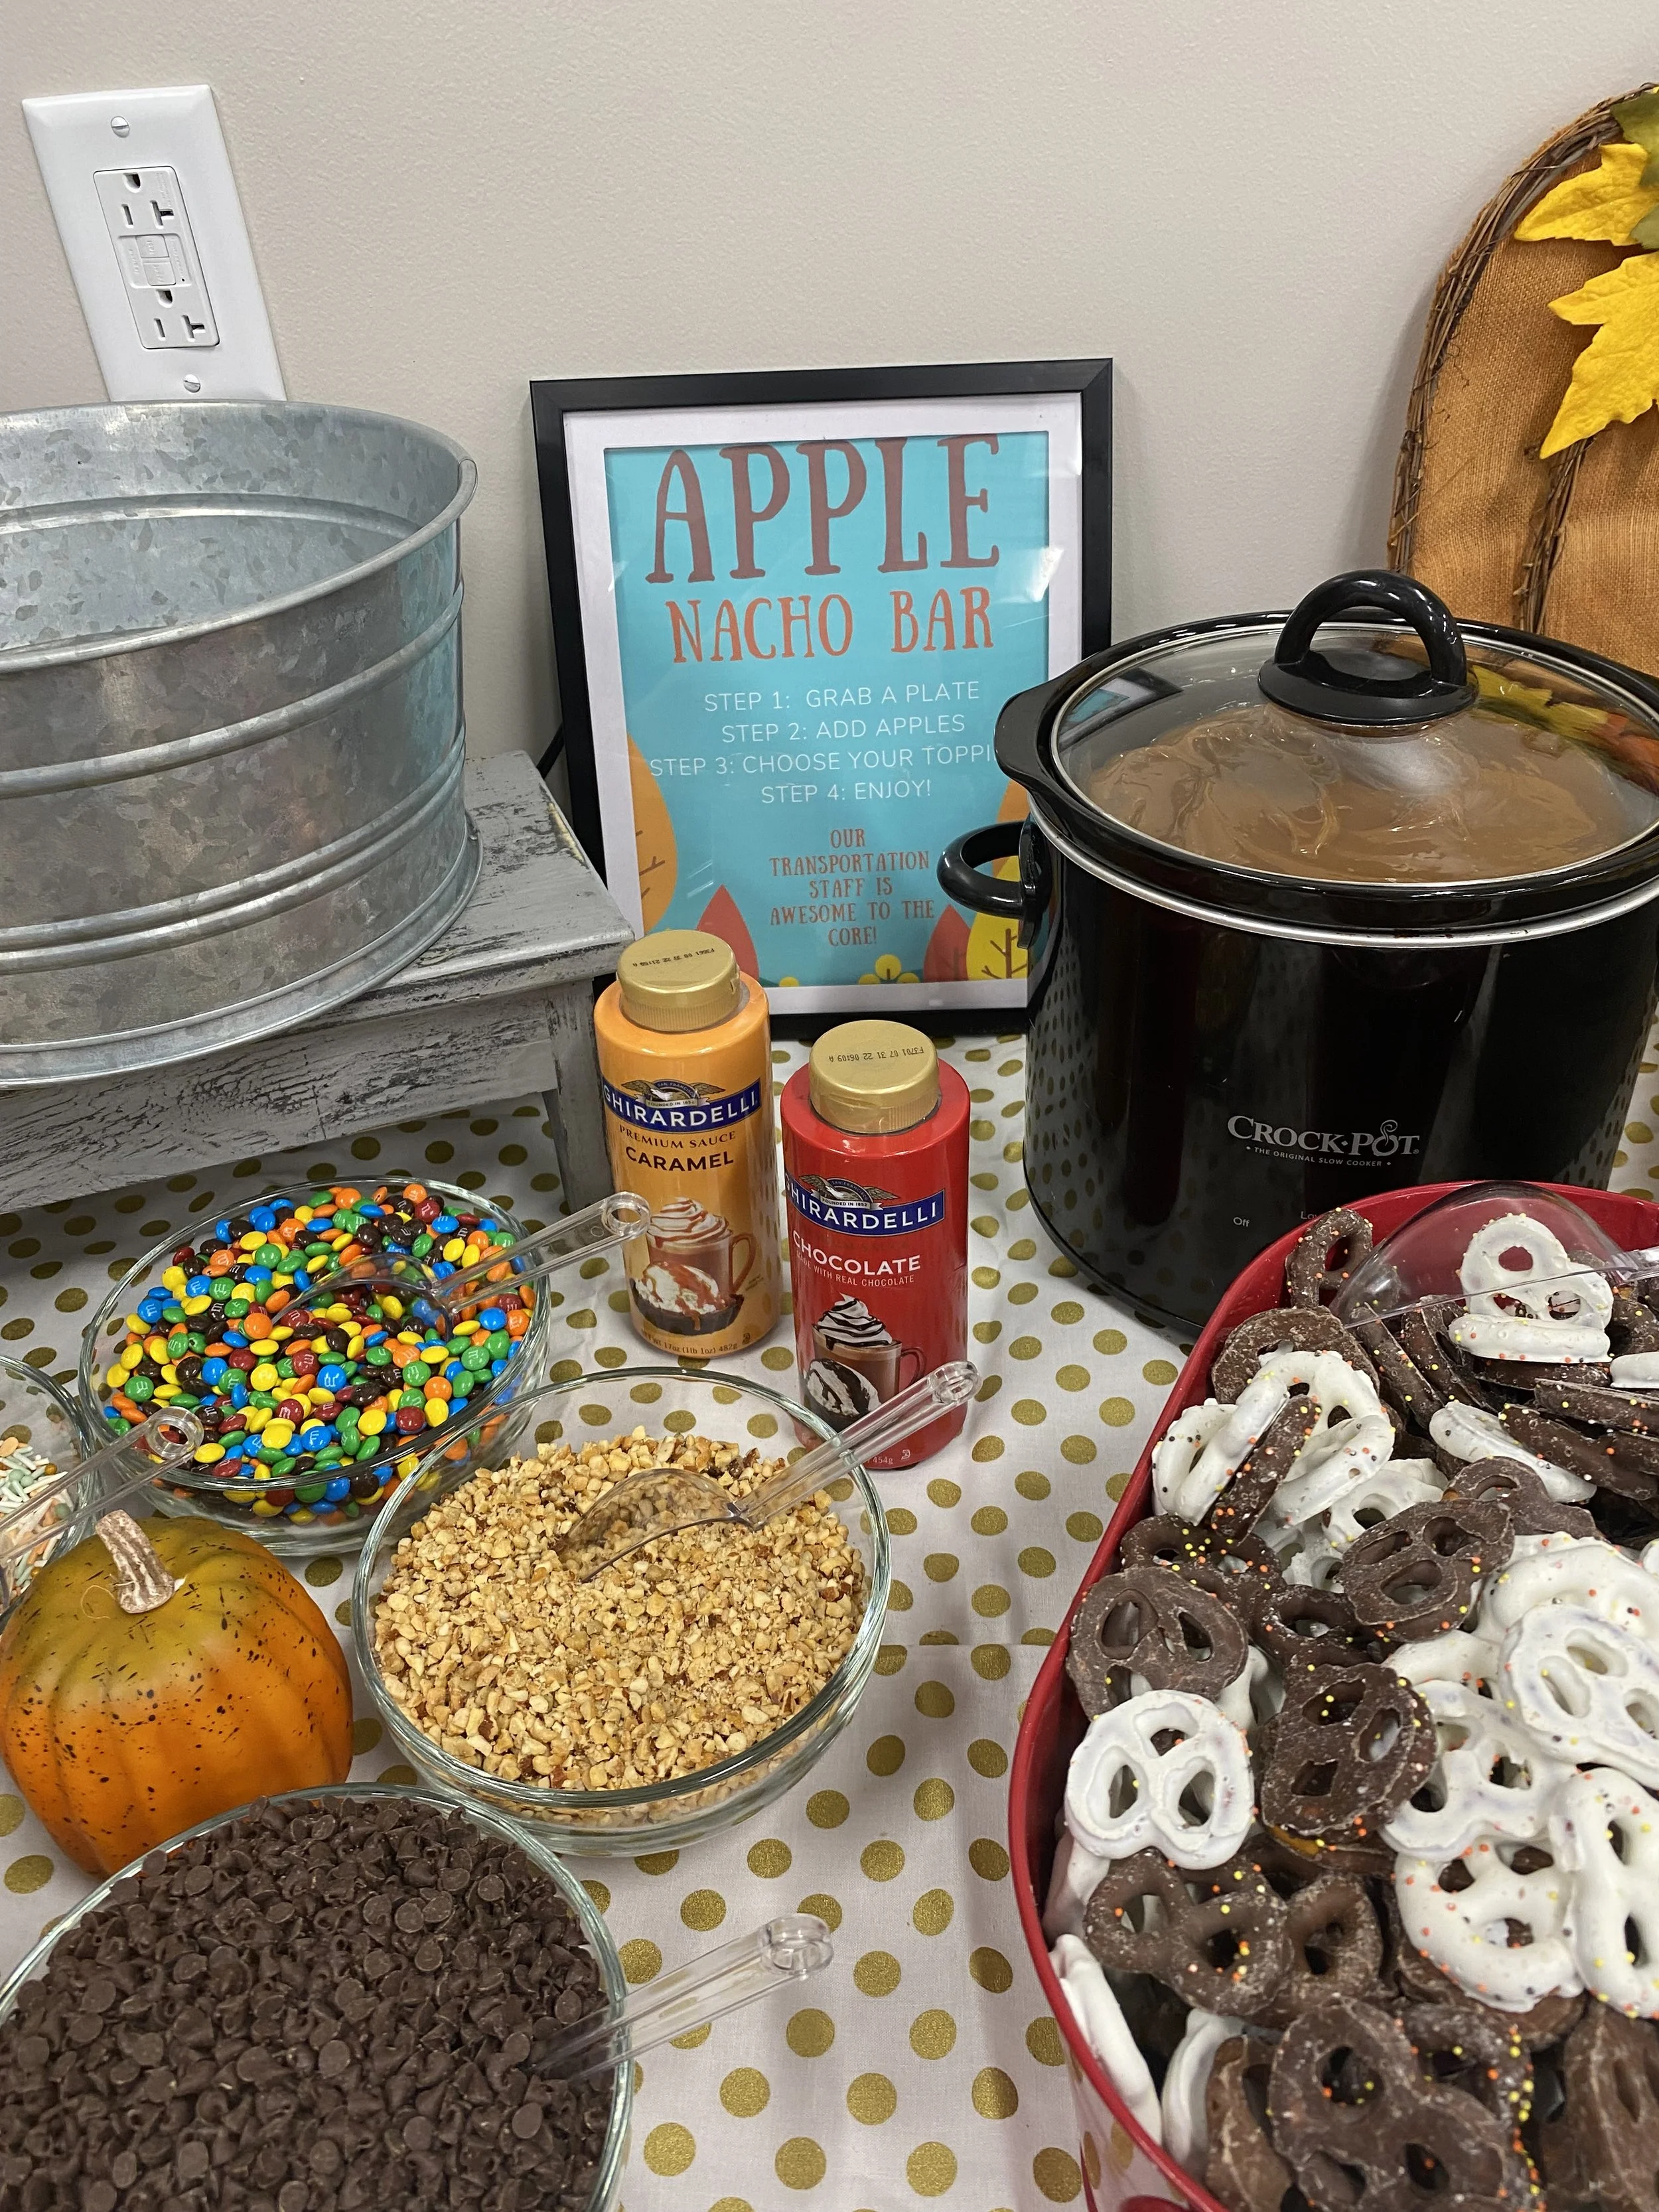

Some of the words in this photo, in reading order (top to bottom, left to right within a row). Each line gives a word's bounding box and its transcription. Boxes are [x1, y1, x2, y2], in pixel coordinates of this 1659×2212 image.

[645, 433, 1000, 584] APPLE
[666, 593, 853, 663] NACHO
[889, 586, 994, 653] BAR
[704, 692, 762, 712] STEP
[772, 691, 790, 709] 1:
[806, 686, 872, 707] GRAB
[881, 686, 897, 703] A
[906, 681, 980, 703] PLATE
[721, 723, 779, 743] STEP
[789, 722, 807, 741] 2:
[816, 719, 867, 740] ADD
[875, 714, 966, 736] APPLES
[650, 757, 706, 777] STEP
[715, 757, 735, 774] 3:
[743, 752, 840, 774] CHOOSE
[848, 749, 912, 769] YOUR
[922, 744, 995, 765] TOPPI
[761, 784, 818, 804] STEP
[827, 784, 845, 800] 4:
[855, 779, 931, 800] ENJOY!
[830, 828, 865, 849] OUR
[770, 851, 929, 877] TRANSPORTATION
[810, 878, 865, 899] STAFF
[876, 877, 893, 895] IS
[770, 903, 856, 925] AWESOME
[867, 902, 891, 920] TO
[901, 900, 934, 919] THE
[828, 926, 877, 946] CORE!
[902, 1047, 924, 1056] F3701
[603, 1084, 756, 1127] GHIRARDELLI
[620, 1124, 684, 1148] PREMIUM
[689, 1131, 736, 1148] SAUCE
[626, 1146, 734, 1171] CARAMEL
[1273, 1151, 1315, 1163] ORIGINAL
[785, 1173, 936, 1230] GHIRARDELLI
[1233, 1217, 1250, 1227] Off
[1300, 1211, 1317, 1220] Lo
[793, 1230, 921, 1276] CHOCOLATE
[814, 1266, 832, 1280] WITH
[836, 1274, 858, 1286] REAL
[861, 1274, 914, 1287] CHOCOLATE
[664, 1342, 680, 1353] 17oz
[682, 1346, 697, 1355] (1lb
[701, 1347, 716, 1355] 1oz)
[719, 1343, 737, 1353] 482g
